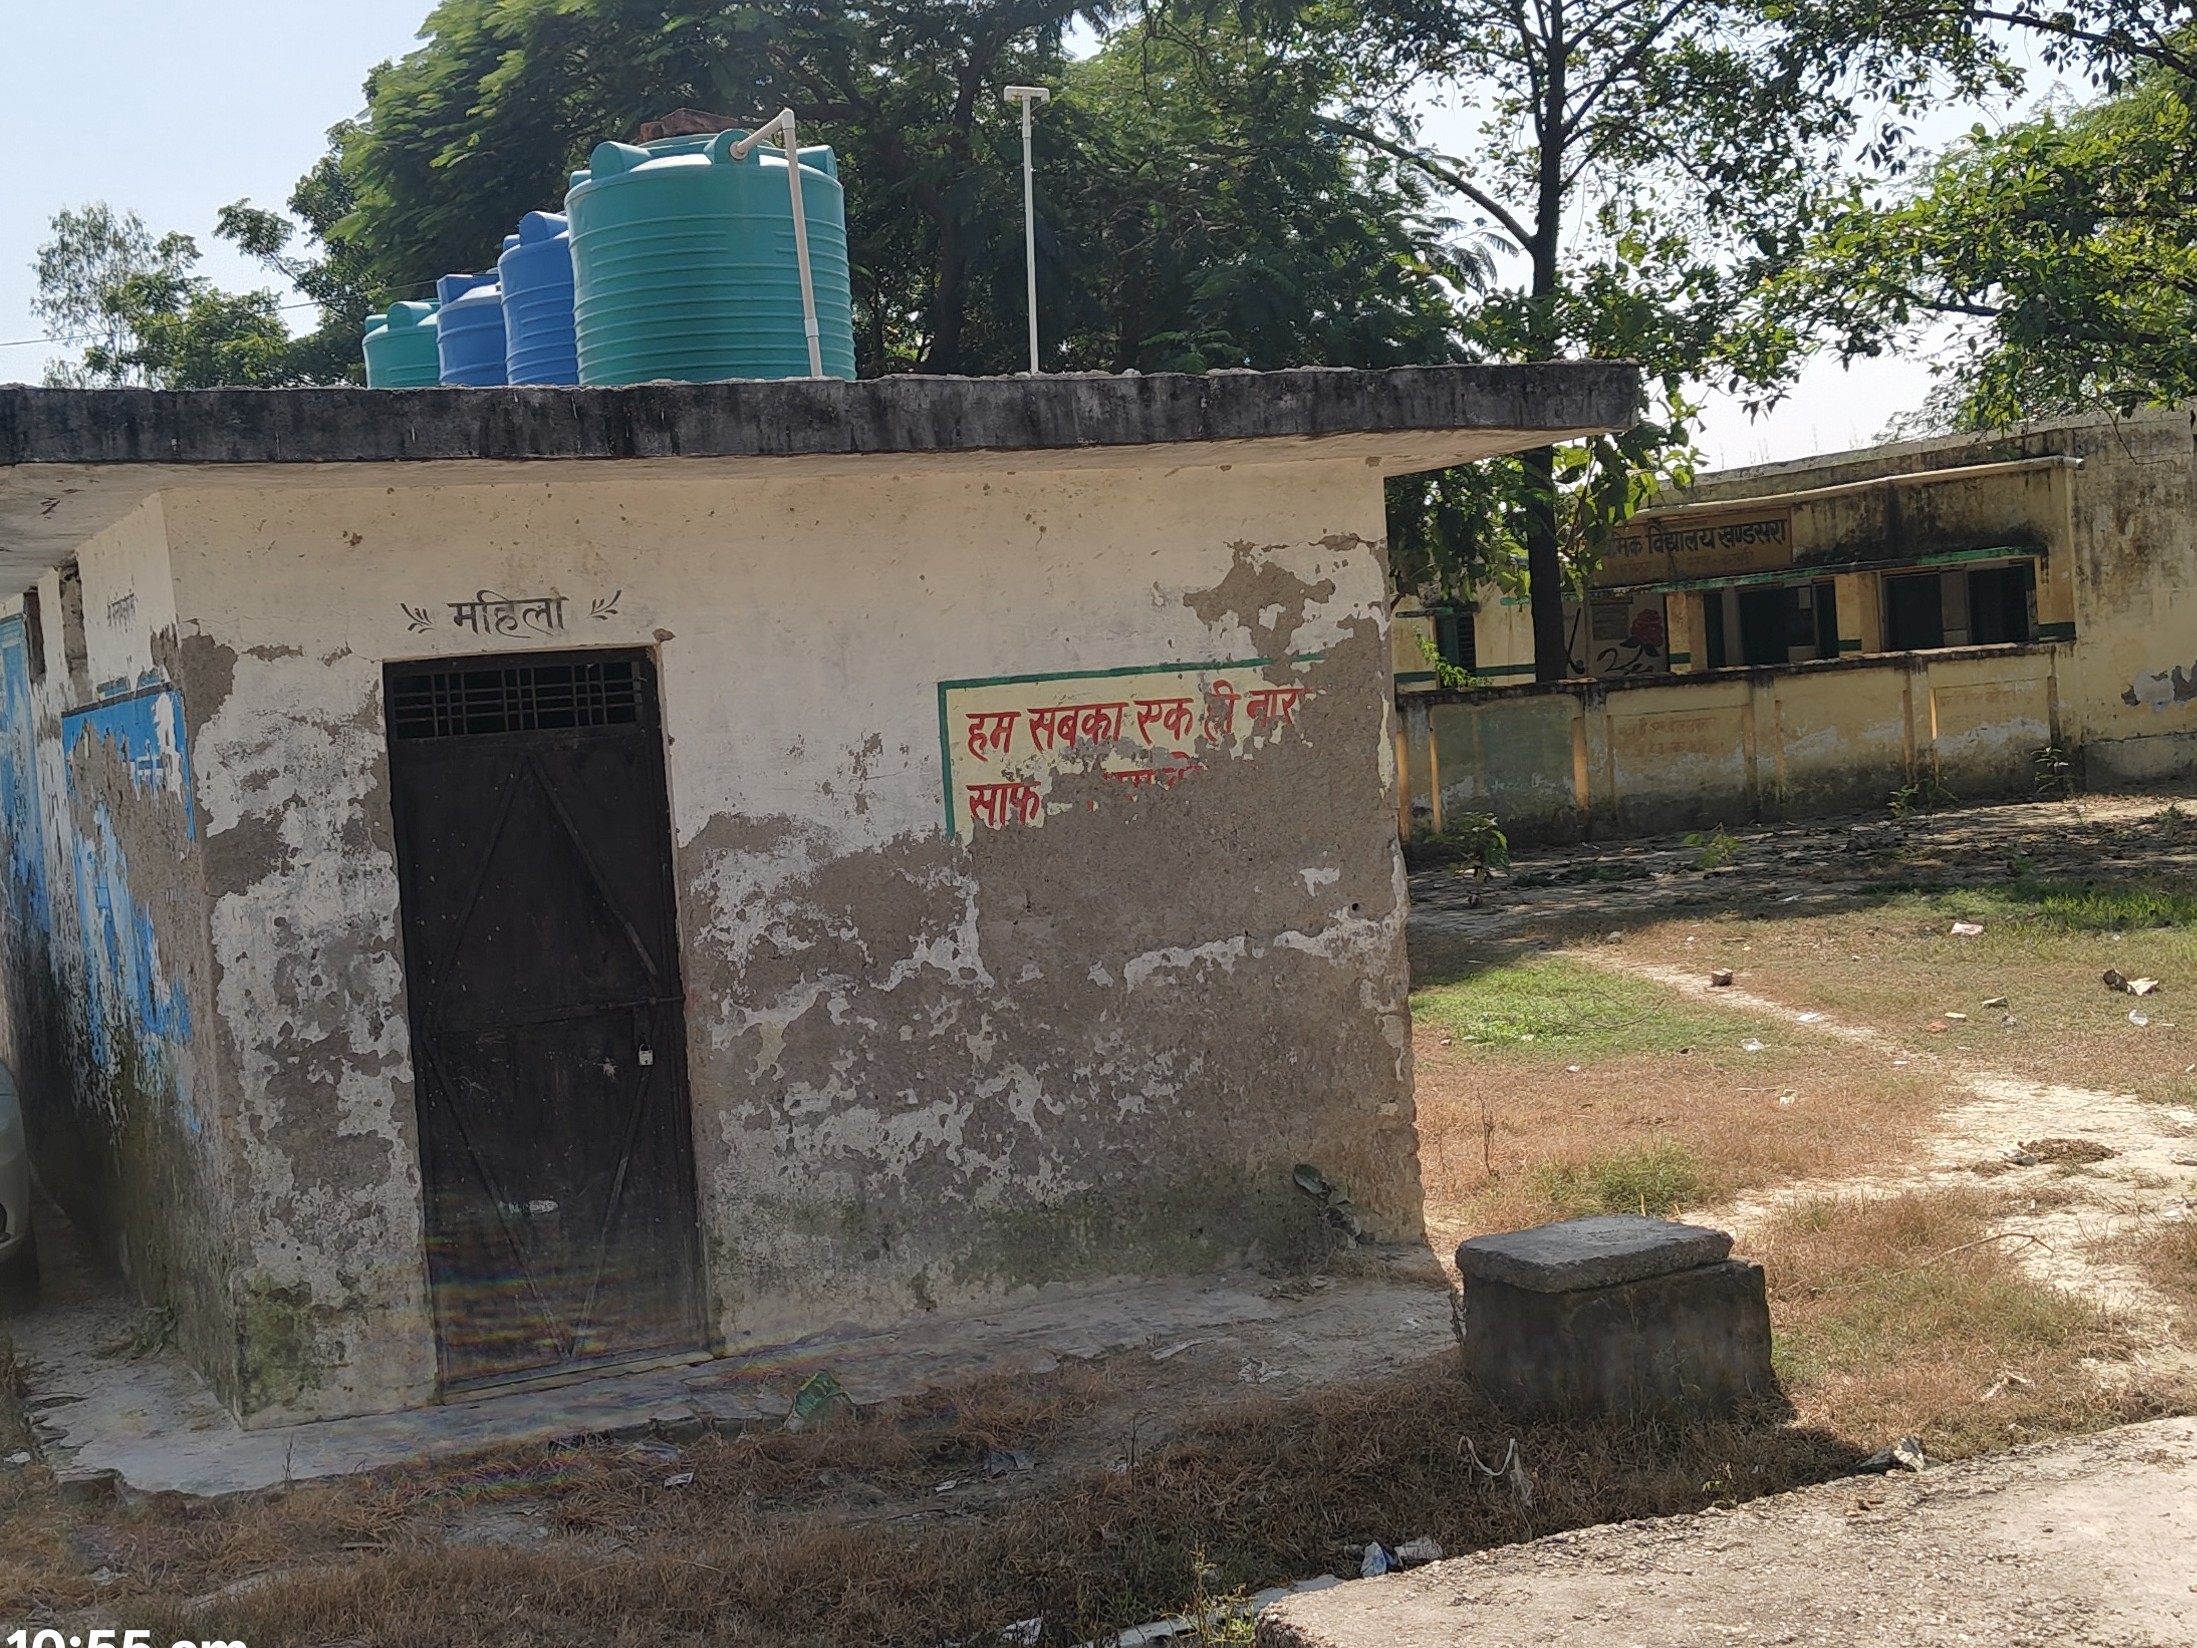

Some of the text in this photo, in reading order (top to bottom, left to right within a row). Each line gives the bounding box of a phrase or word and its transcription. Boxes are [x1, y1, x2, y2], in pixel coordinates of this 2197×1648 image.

[1645, 525, 1716, 556] विद्यालय
[447, 589, 570, 638] महिला
[966, 711, 1021, 762] हम
[1027, 702, 1129, 752] सबका
[966, 781, 1041, 826] साफ
